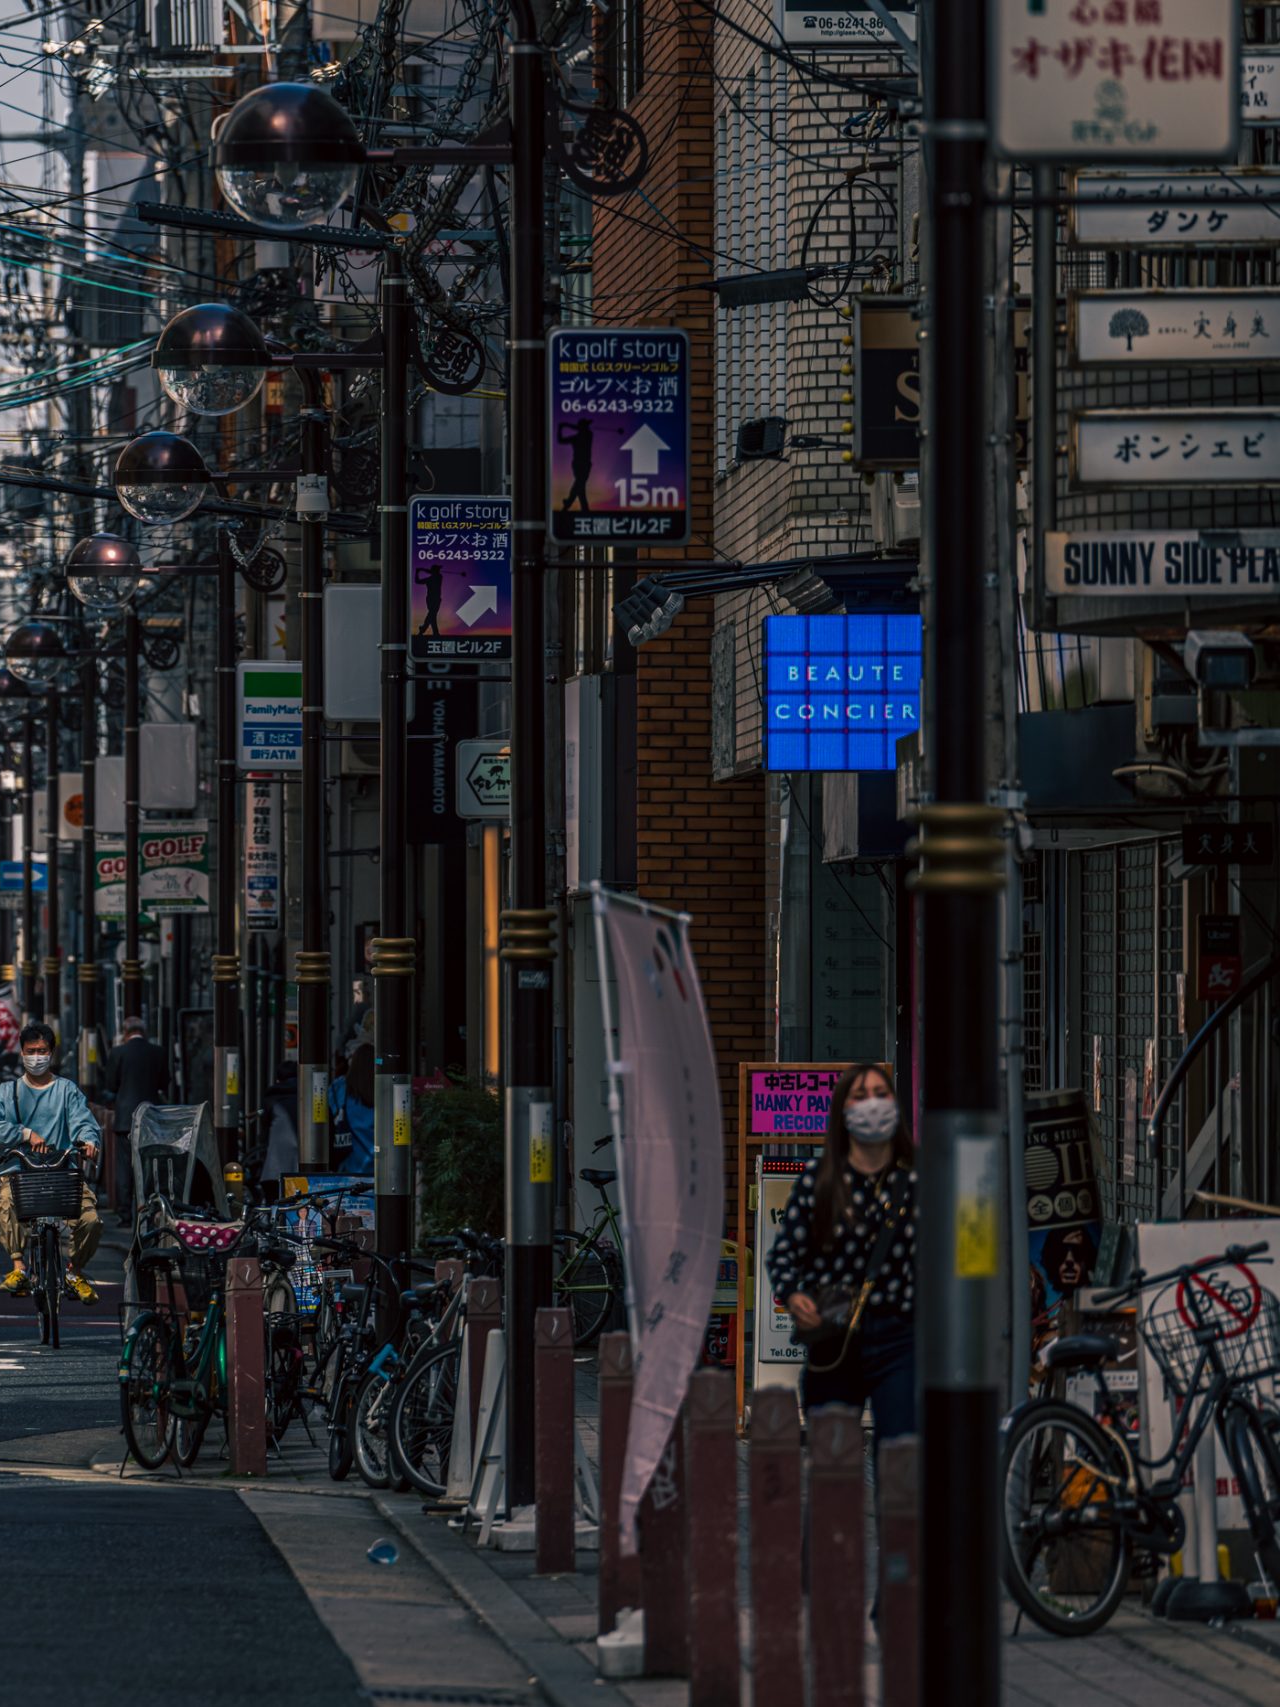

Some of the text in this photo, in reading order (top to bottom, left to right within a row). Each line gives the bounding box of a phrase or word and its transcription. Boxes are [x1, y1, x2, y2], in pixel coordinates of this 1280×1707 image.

[1012, 36, 1223, 82] オザキ花園
[1148, 209, 1228, 233] ダンケ
[559, 337, 680, 362] k golf story
[561, 399, 674, 413] 06-6243-9322
[614, 478, 680, 508] 15m
[416, 503, 510, 522] k golf story
[573, 517, 672, 536] 玉置ビル2F
[418, 550, 505, 561] 06-6243-9322
[1064, 541, 1155, 586] SUNNY
[1165, 541, 1223, 585] SIDE
[426, 640, 503, 655] 玉置ビル2F
[787, 665, 904, 682] BEAUTE
[775, 703, 916, 720] CONCIER
[251, 731, 265, 745] 酒
[432, 740, 447, 815] YAMAMOTO
[144, 836, 204, 858] GOLF
[765, 1073, 842, 1091] 中古レコード
[755, 1093, 805, 1112] HANKY
